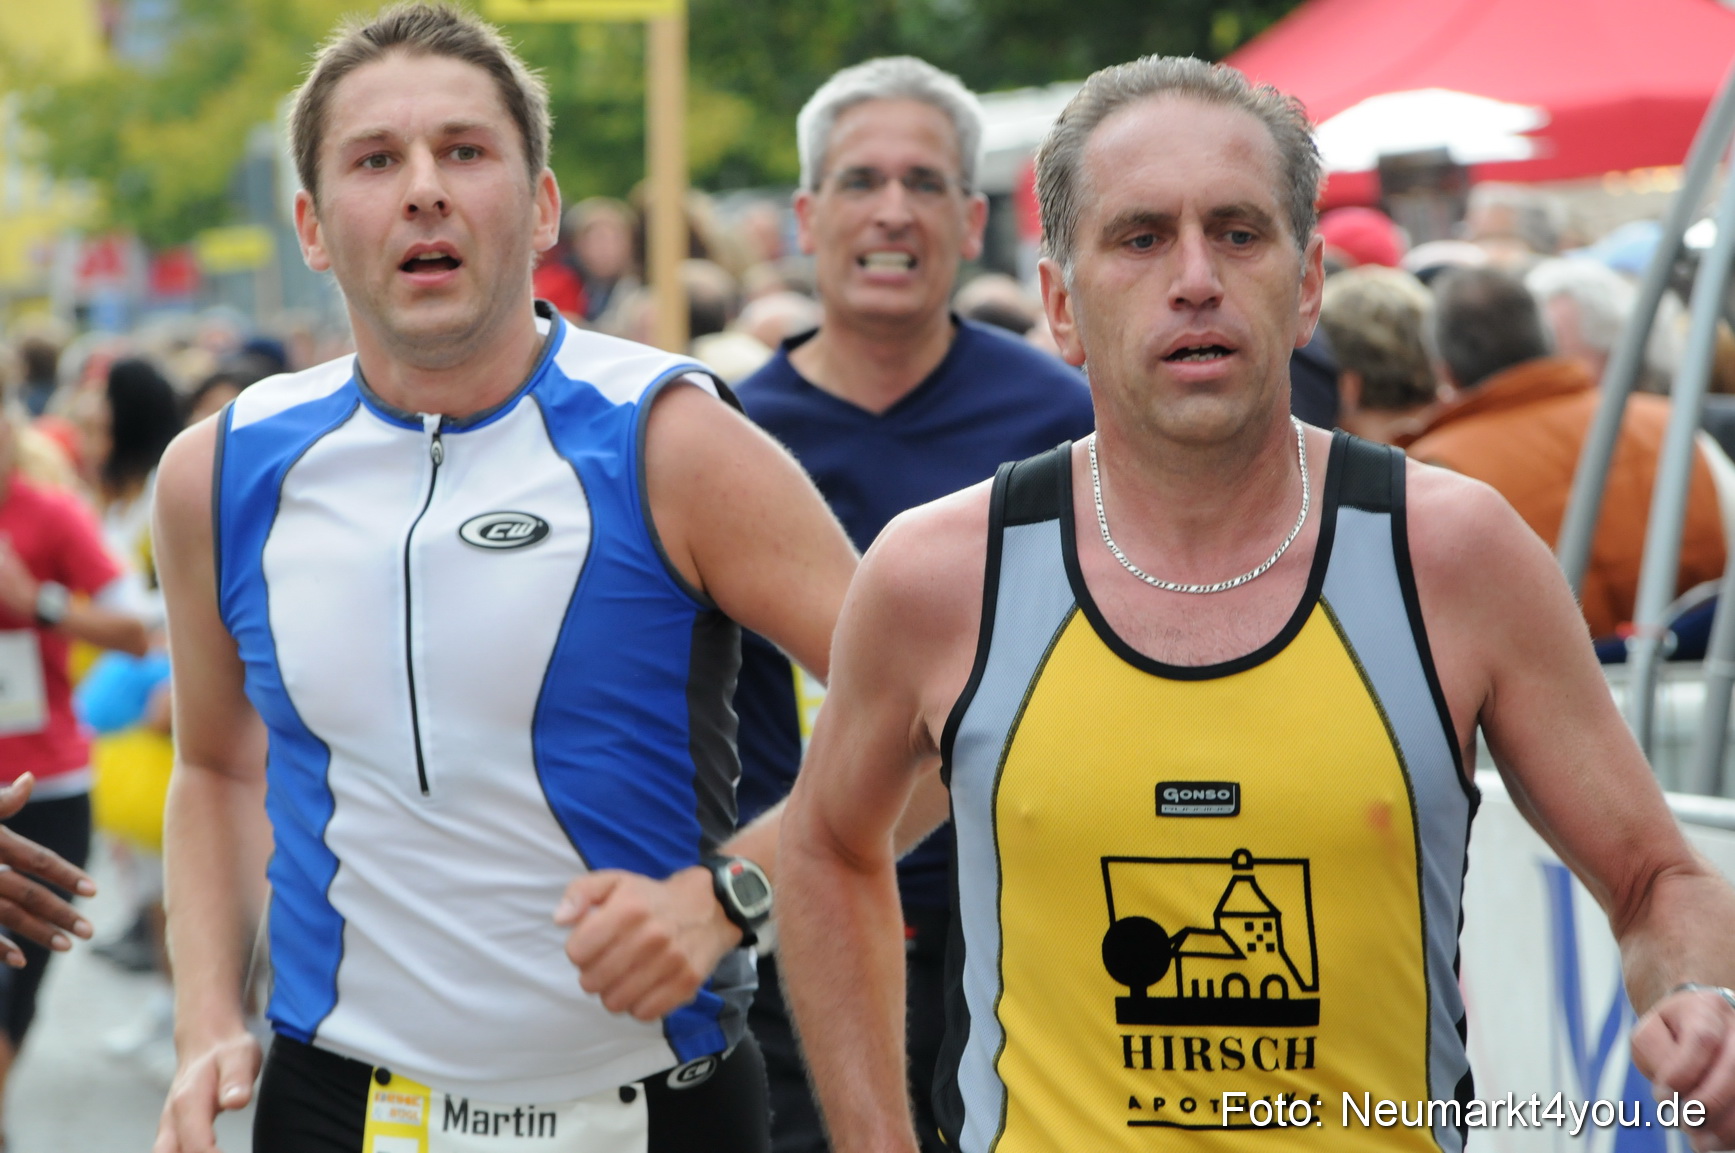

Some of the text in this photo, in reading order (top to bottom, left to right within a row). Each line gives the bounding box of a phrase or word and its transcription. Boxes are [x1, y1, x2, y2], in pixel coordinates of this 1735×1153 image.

[1162, 787, 1231, 804] GONSO
[1119, 1034, 1318, 1072] HIRSCH
[442, 1094, 557, 1138] Martin
